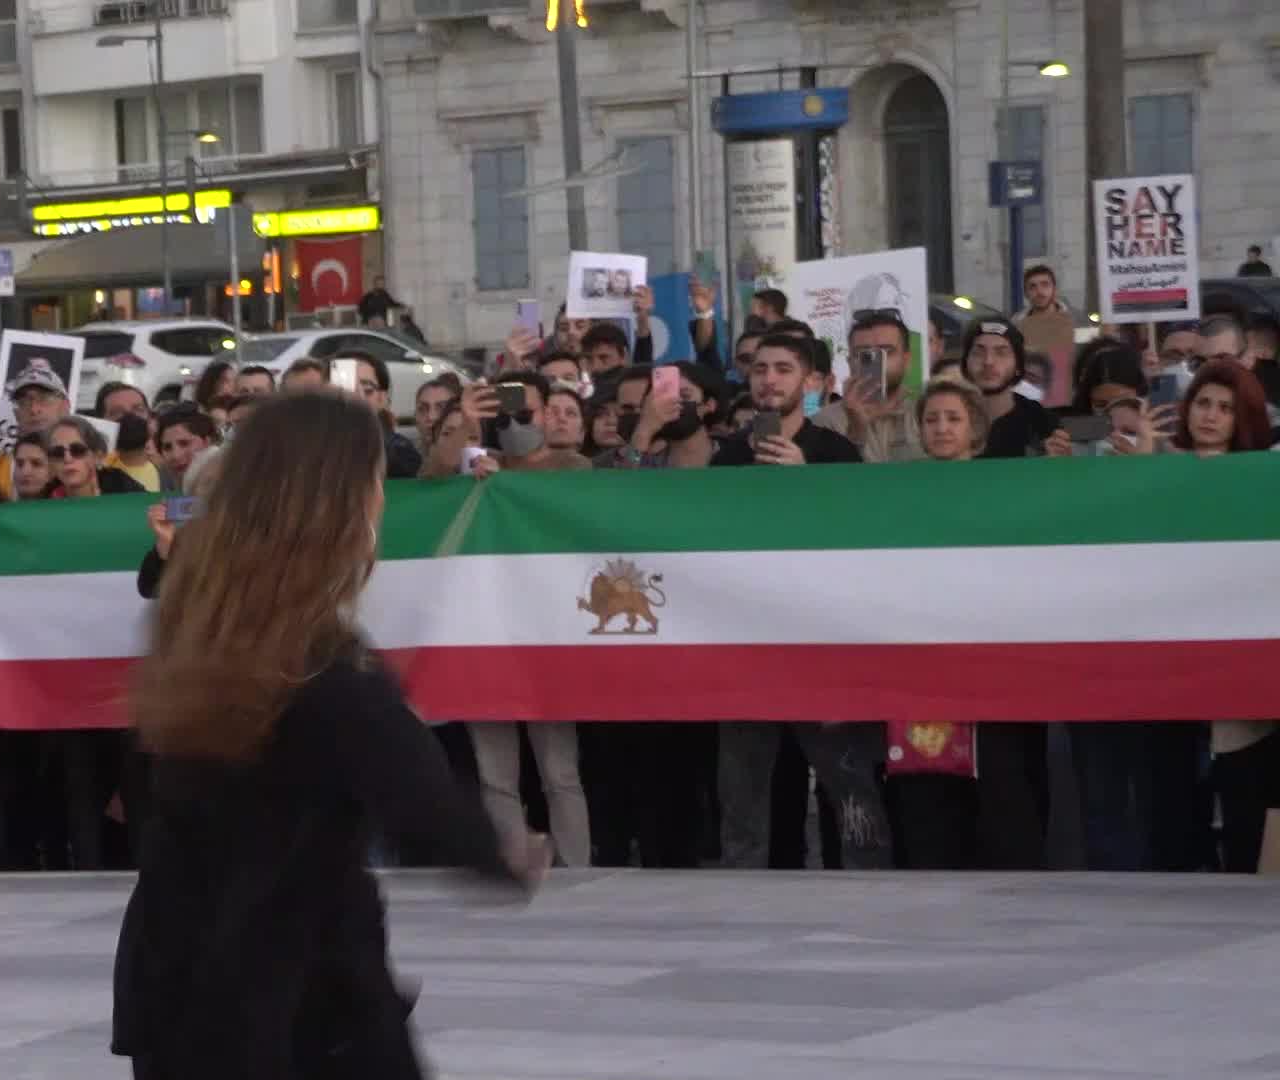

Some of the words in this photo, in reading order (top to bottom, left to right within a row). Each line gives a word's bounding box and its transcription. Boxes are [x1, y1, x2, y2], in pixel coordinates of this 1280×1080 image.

[1105, 185, 1183, 214] SAY
[1106, 213, 1184, 240] HER
[1107, 239, 1186, 258] NAME
